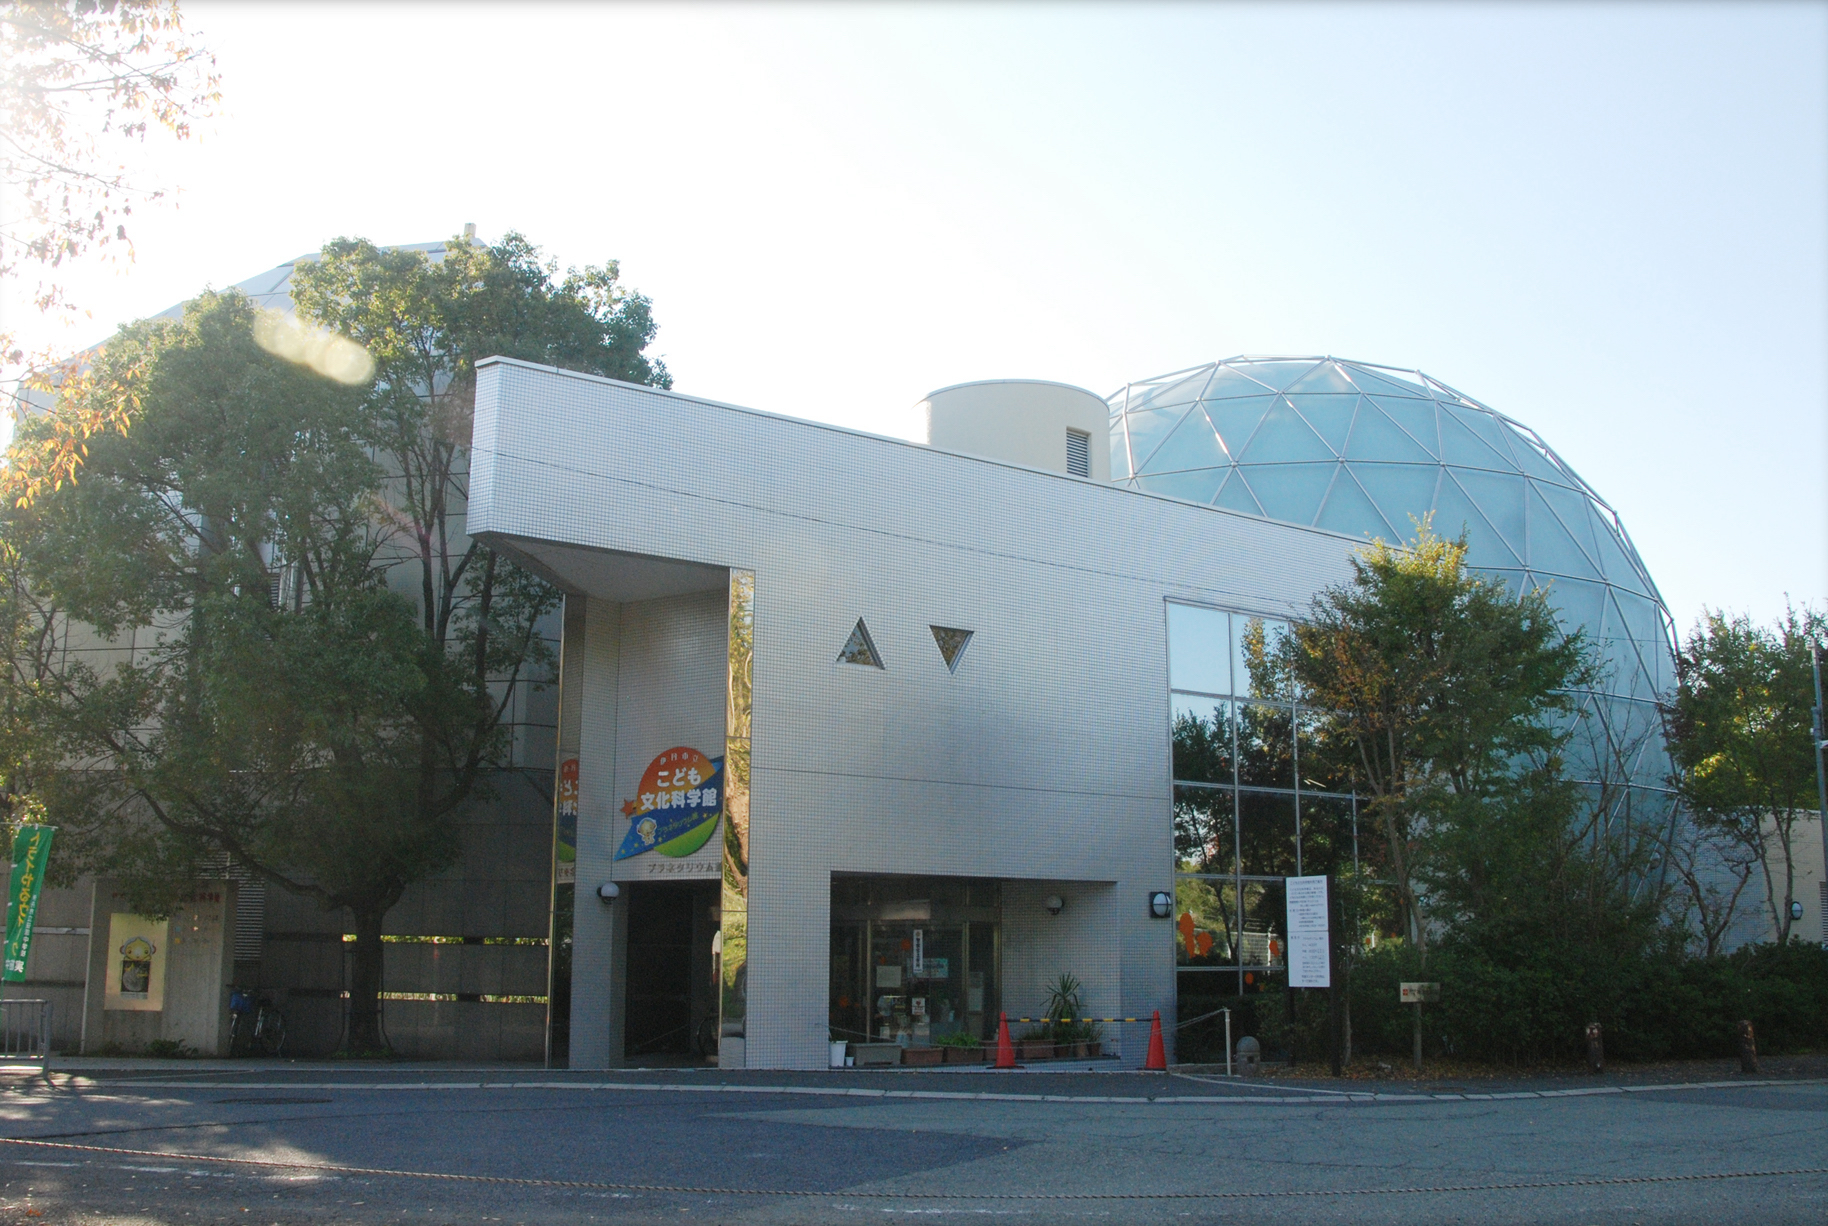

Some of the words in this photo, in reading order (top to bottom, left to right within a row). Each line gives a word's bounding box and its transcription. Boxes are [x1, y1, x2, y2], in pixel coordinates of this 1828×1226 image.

[657, 767, 702, 788] こども
[640, 788, 718, 811] 文化科学館
